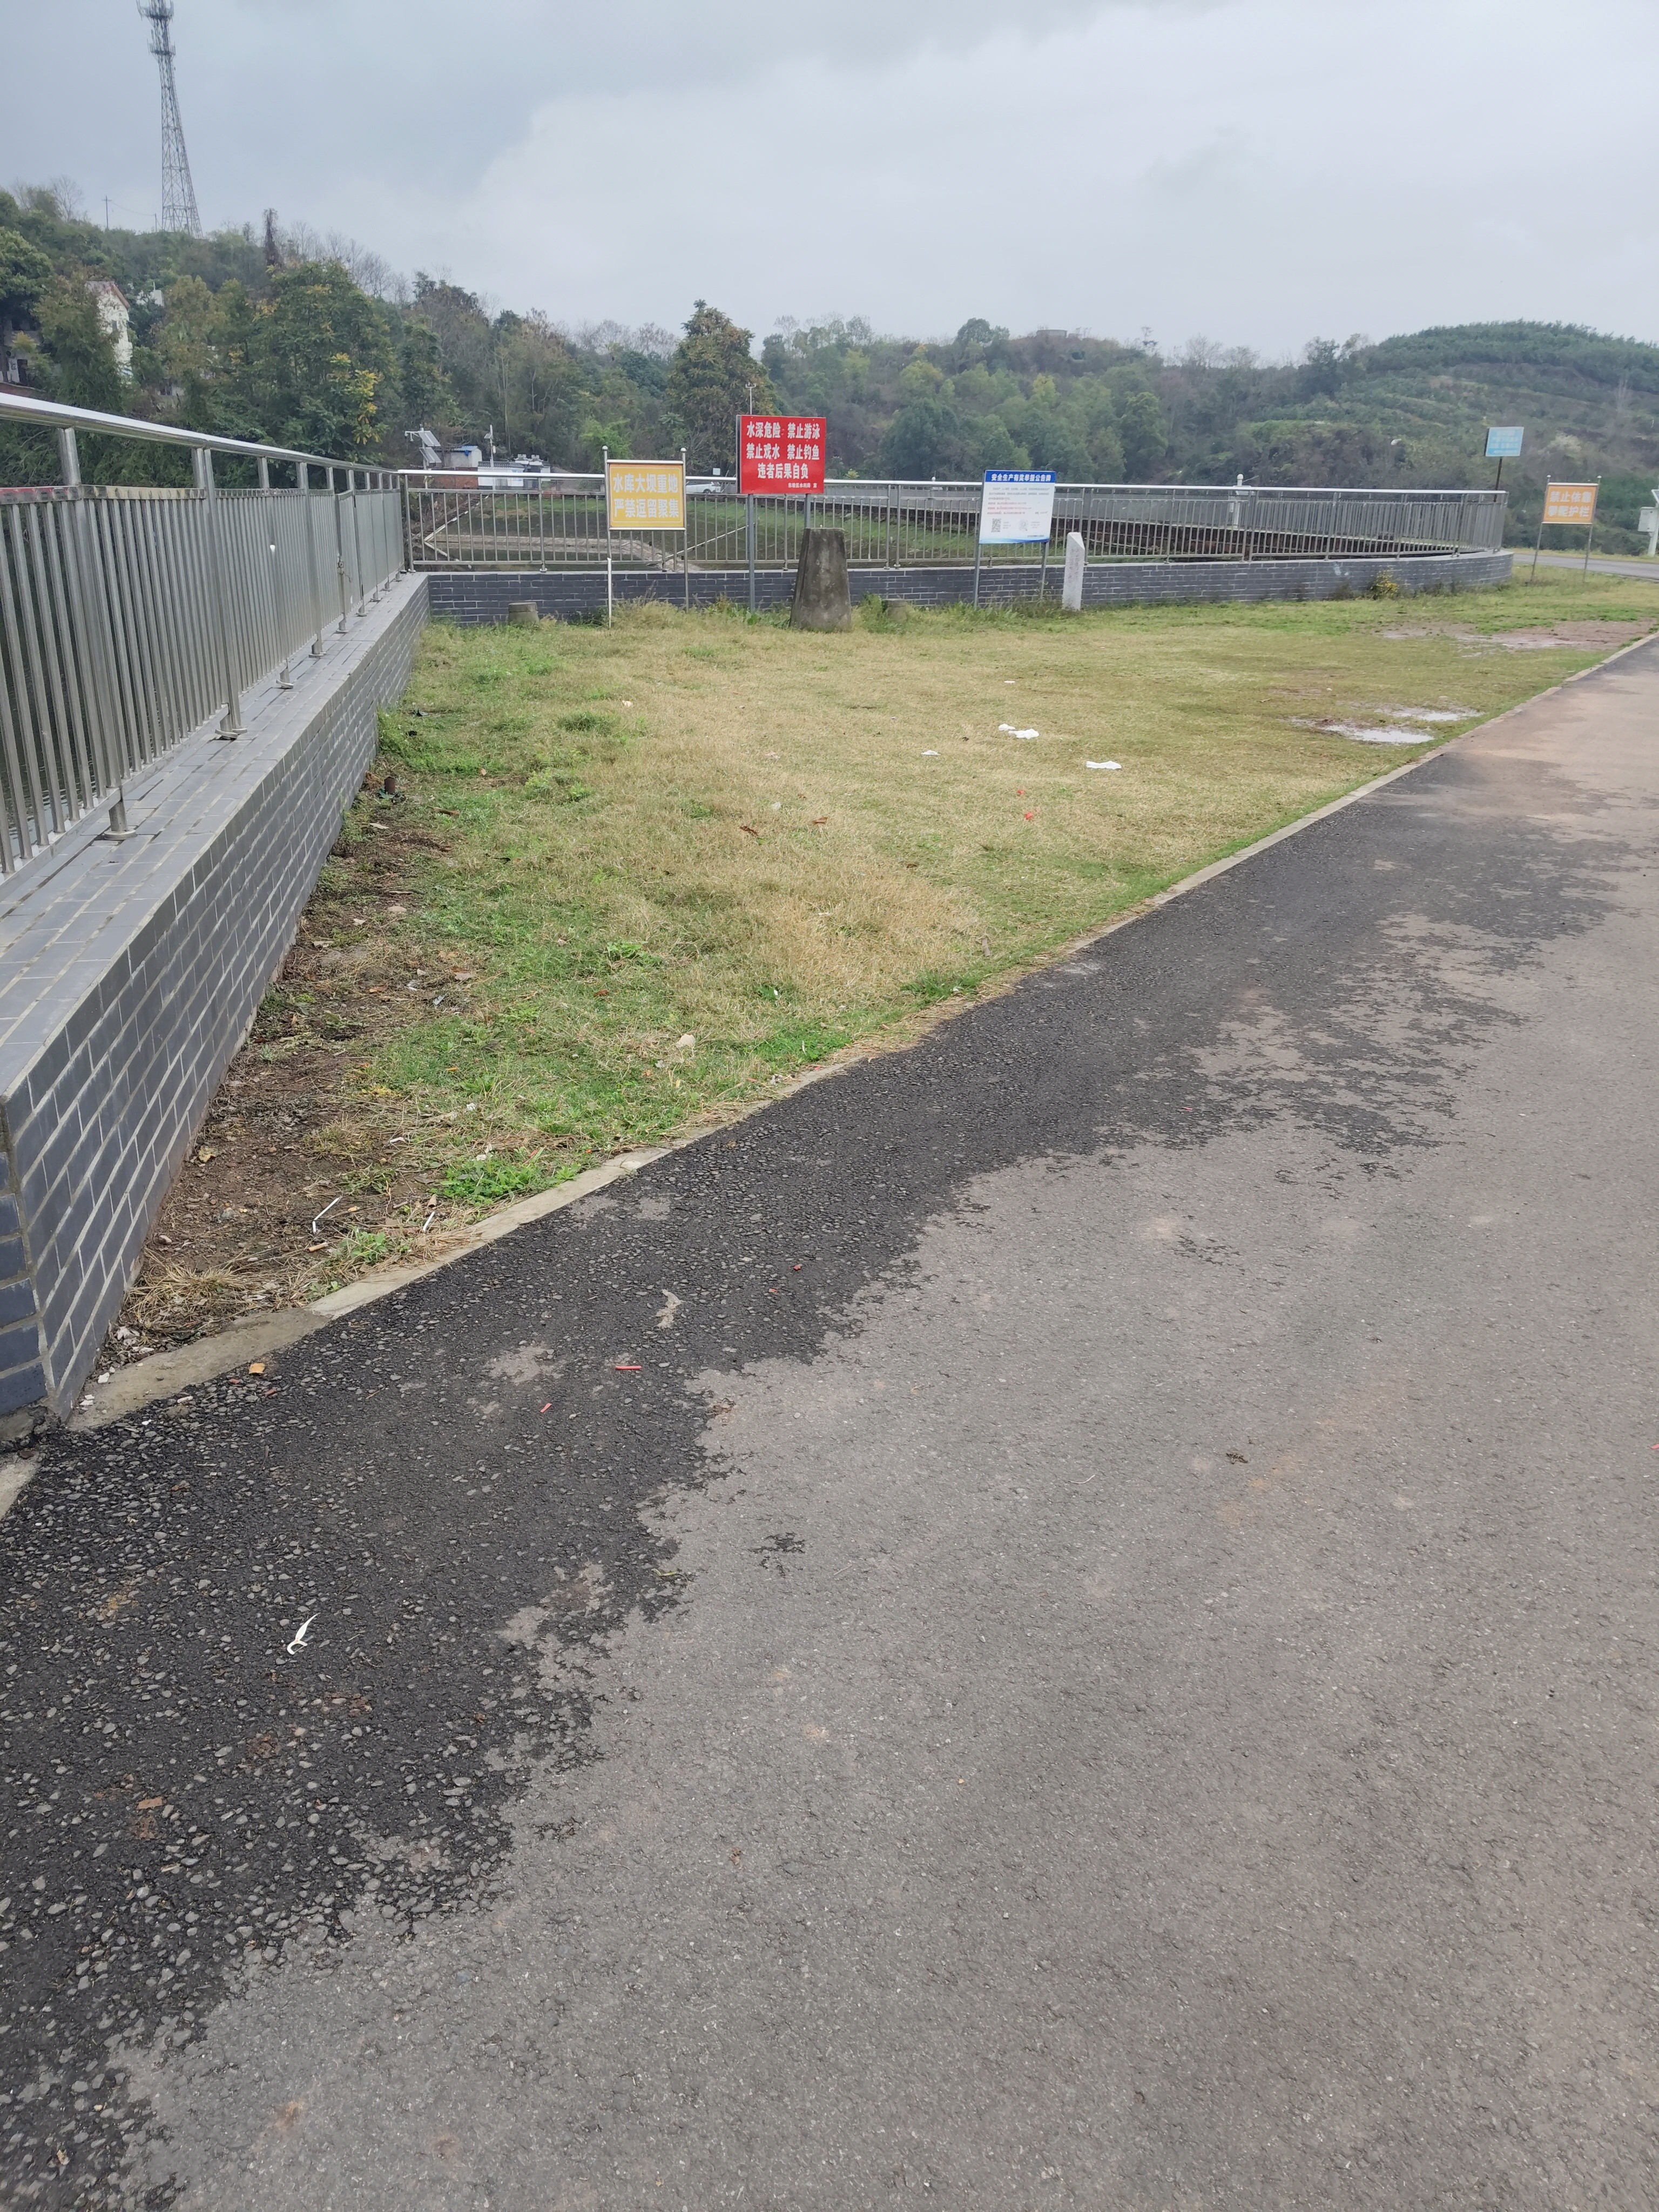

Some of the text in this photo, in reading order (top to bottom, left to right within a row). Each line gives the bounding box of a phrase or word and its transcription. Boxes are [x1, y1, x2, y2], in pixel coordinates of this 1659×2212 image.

[747, 421, 820, 439] 水深危险 禁止游泳
[746, 443, 820, 460] 禁止戏水 禁止钓鱼
[758, 462, 808, 479] 违者后果自负
[992, 473, 1052, 482] 安全生产有奖举报公告牌
[613, 472, 678, 494] 水库大坝重地
[613, 497, 679, 518] 严禁逗留聚集
